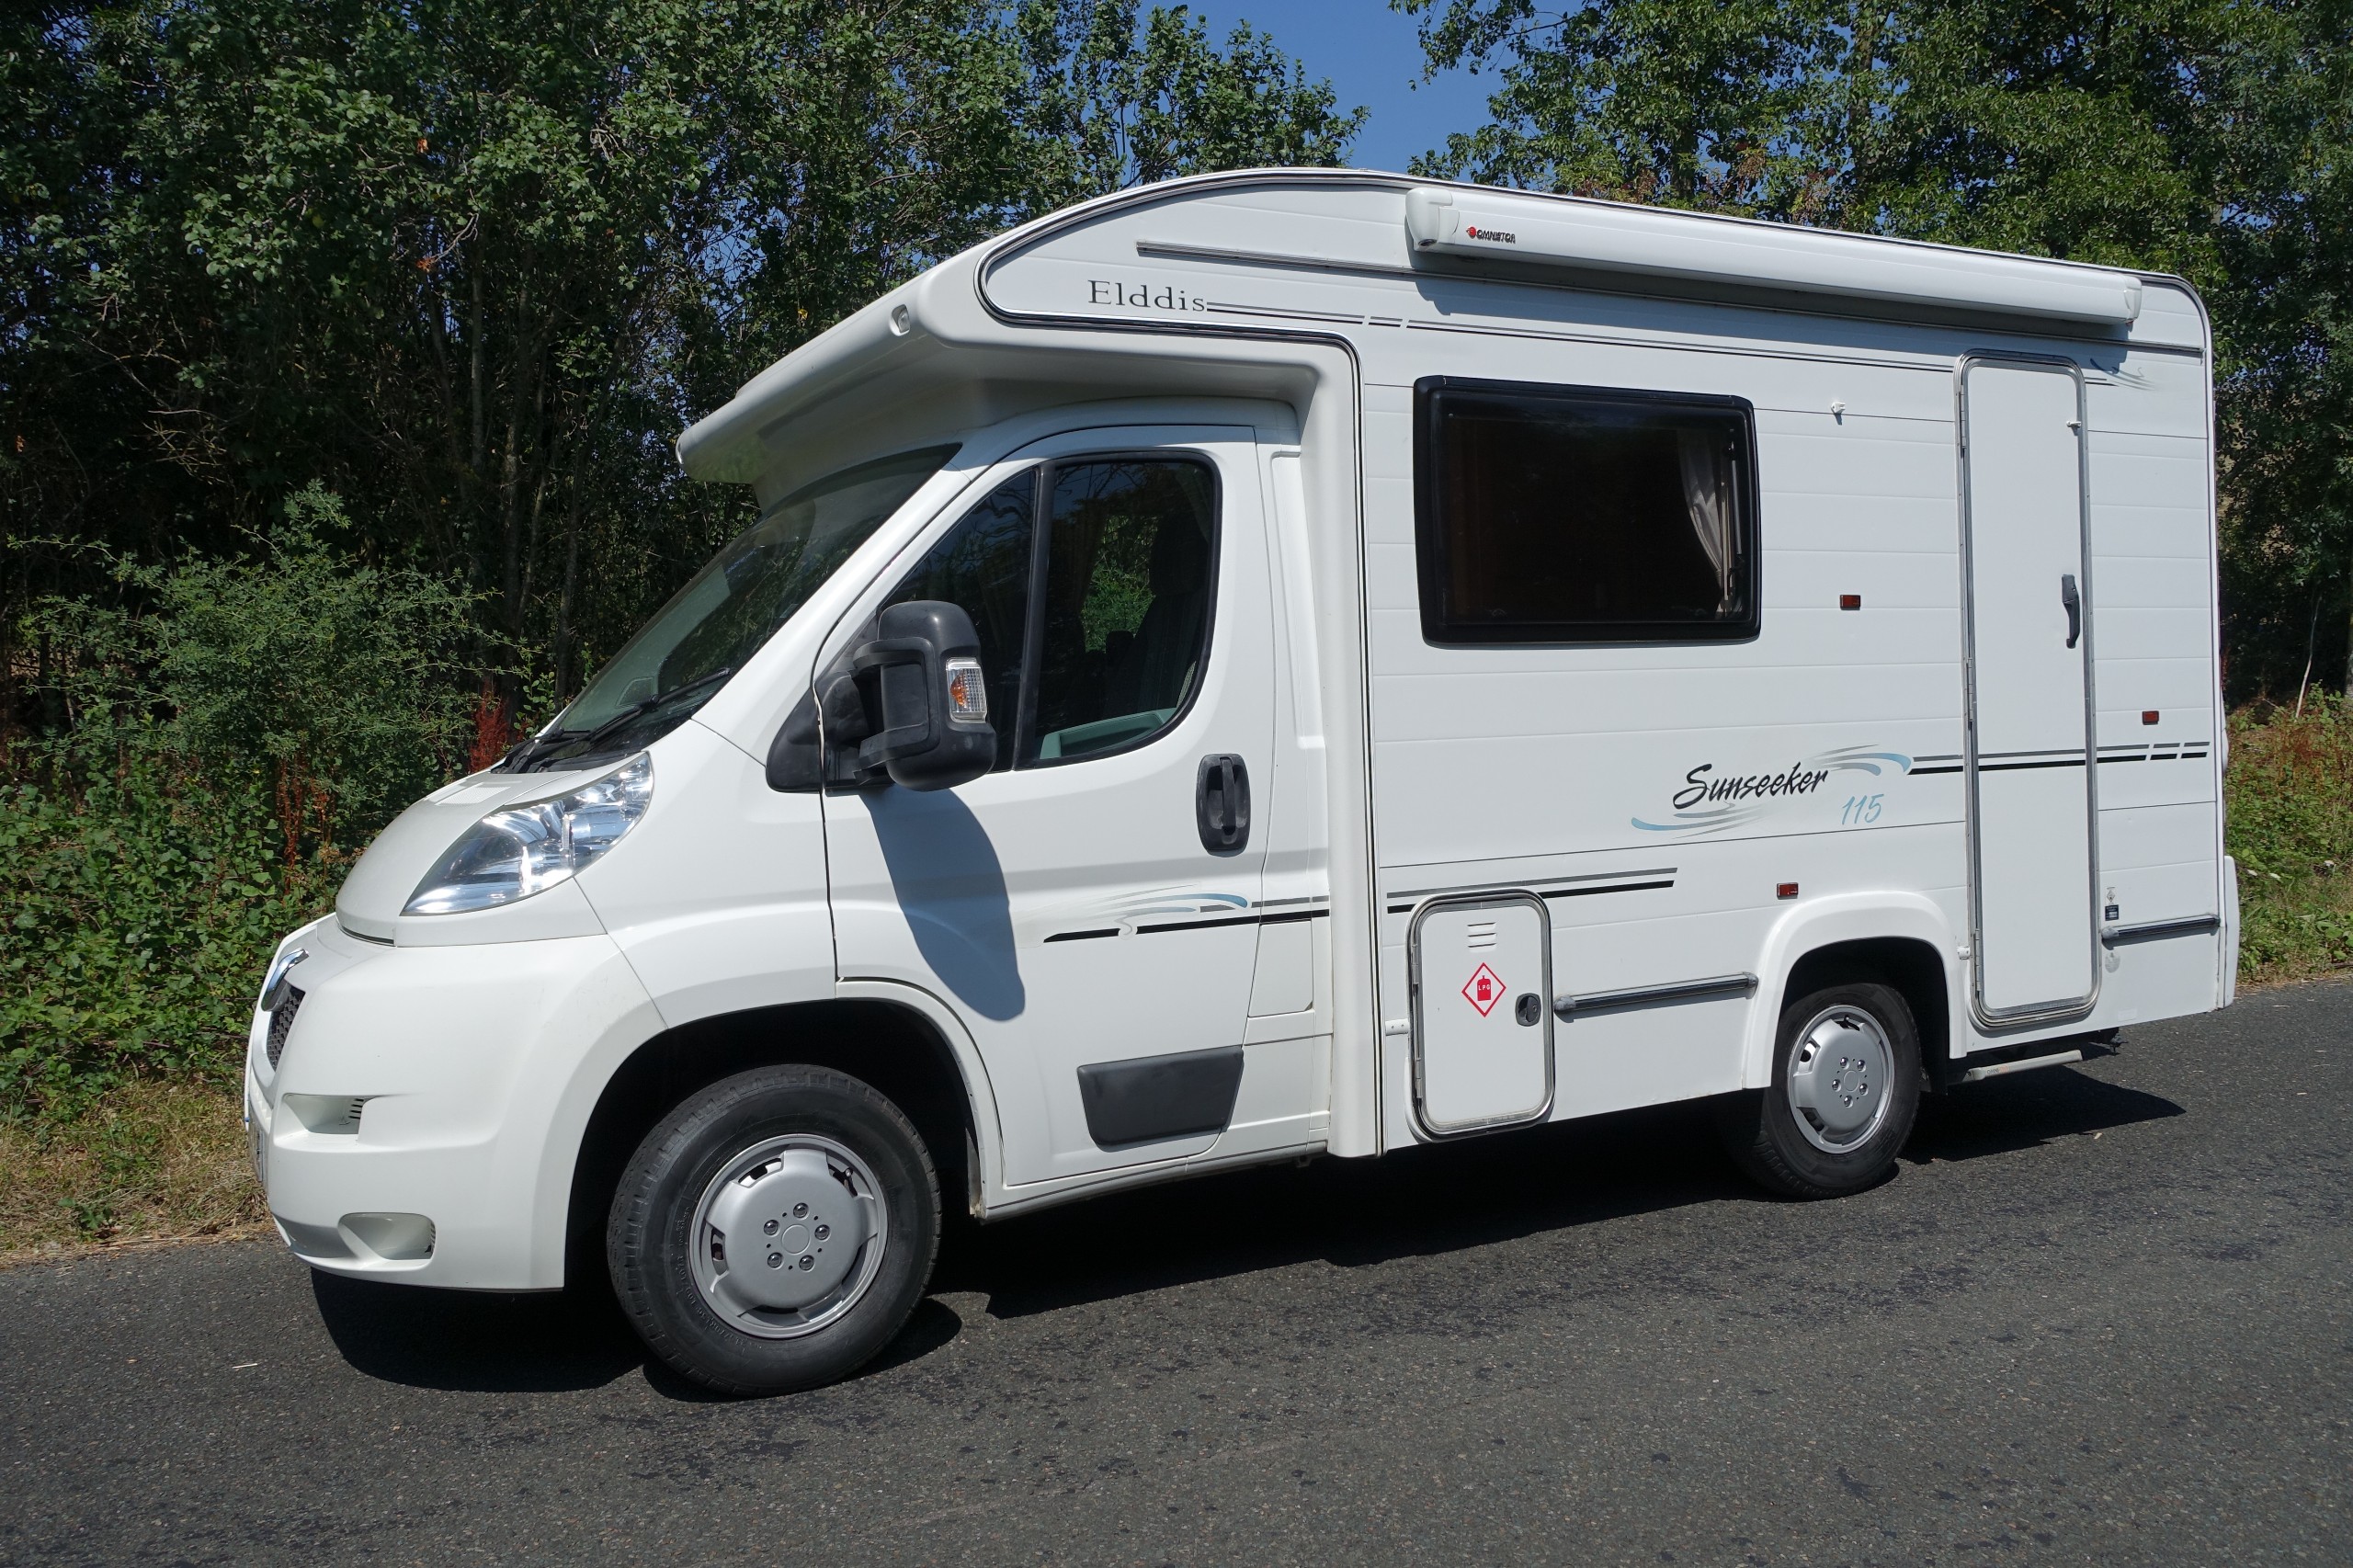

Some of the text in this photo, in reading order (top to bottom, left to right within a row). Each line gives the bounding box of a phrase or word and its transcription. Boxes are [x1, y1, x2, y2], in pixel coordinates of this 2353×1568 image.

[1087, 279, 1205, 312] Elddis
[1673, 762, 1828, 810] Sunseeker
[1841, 793, 1884, 825] 115
